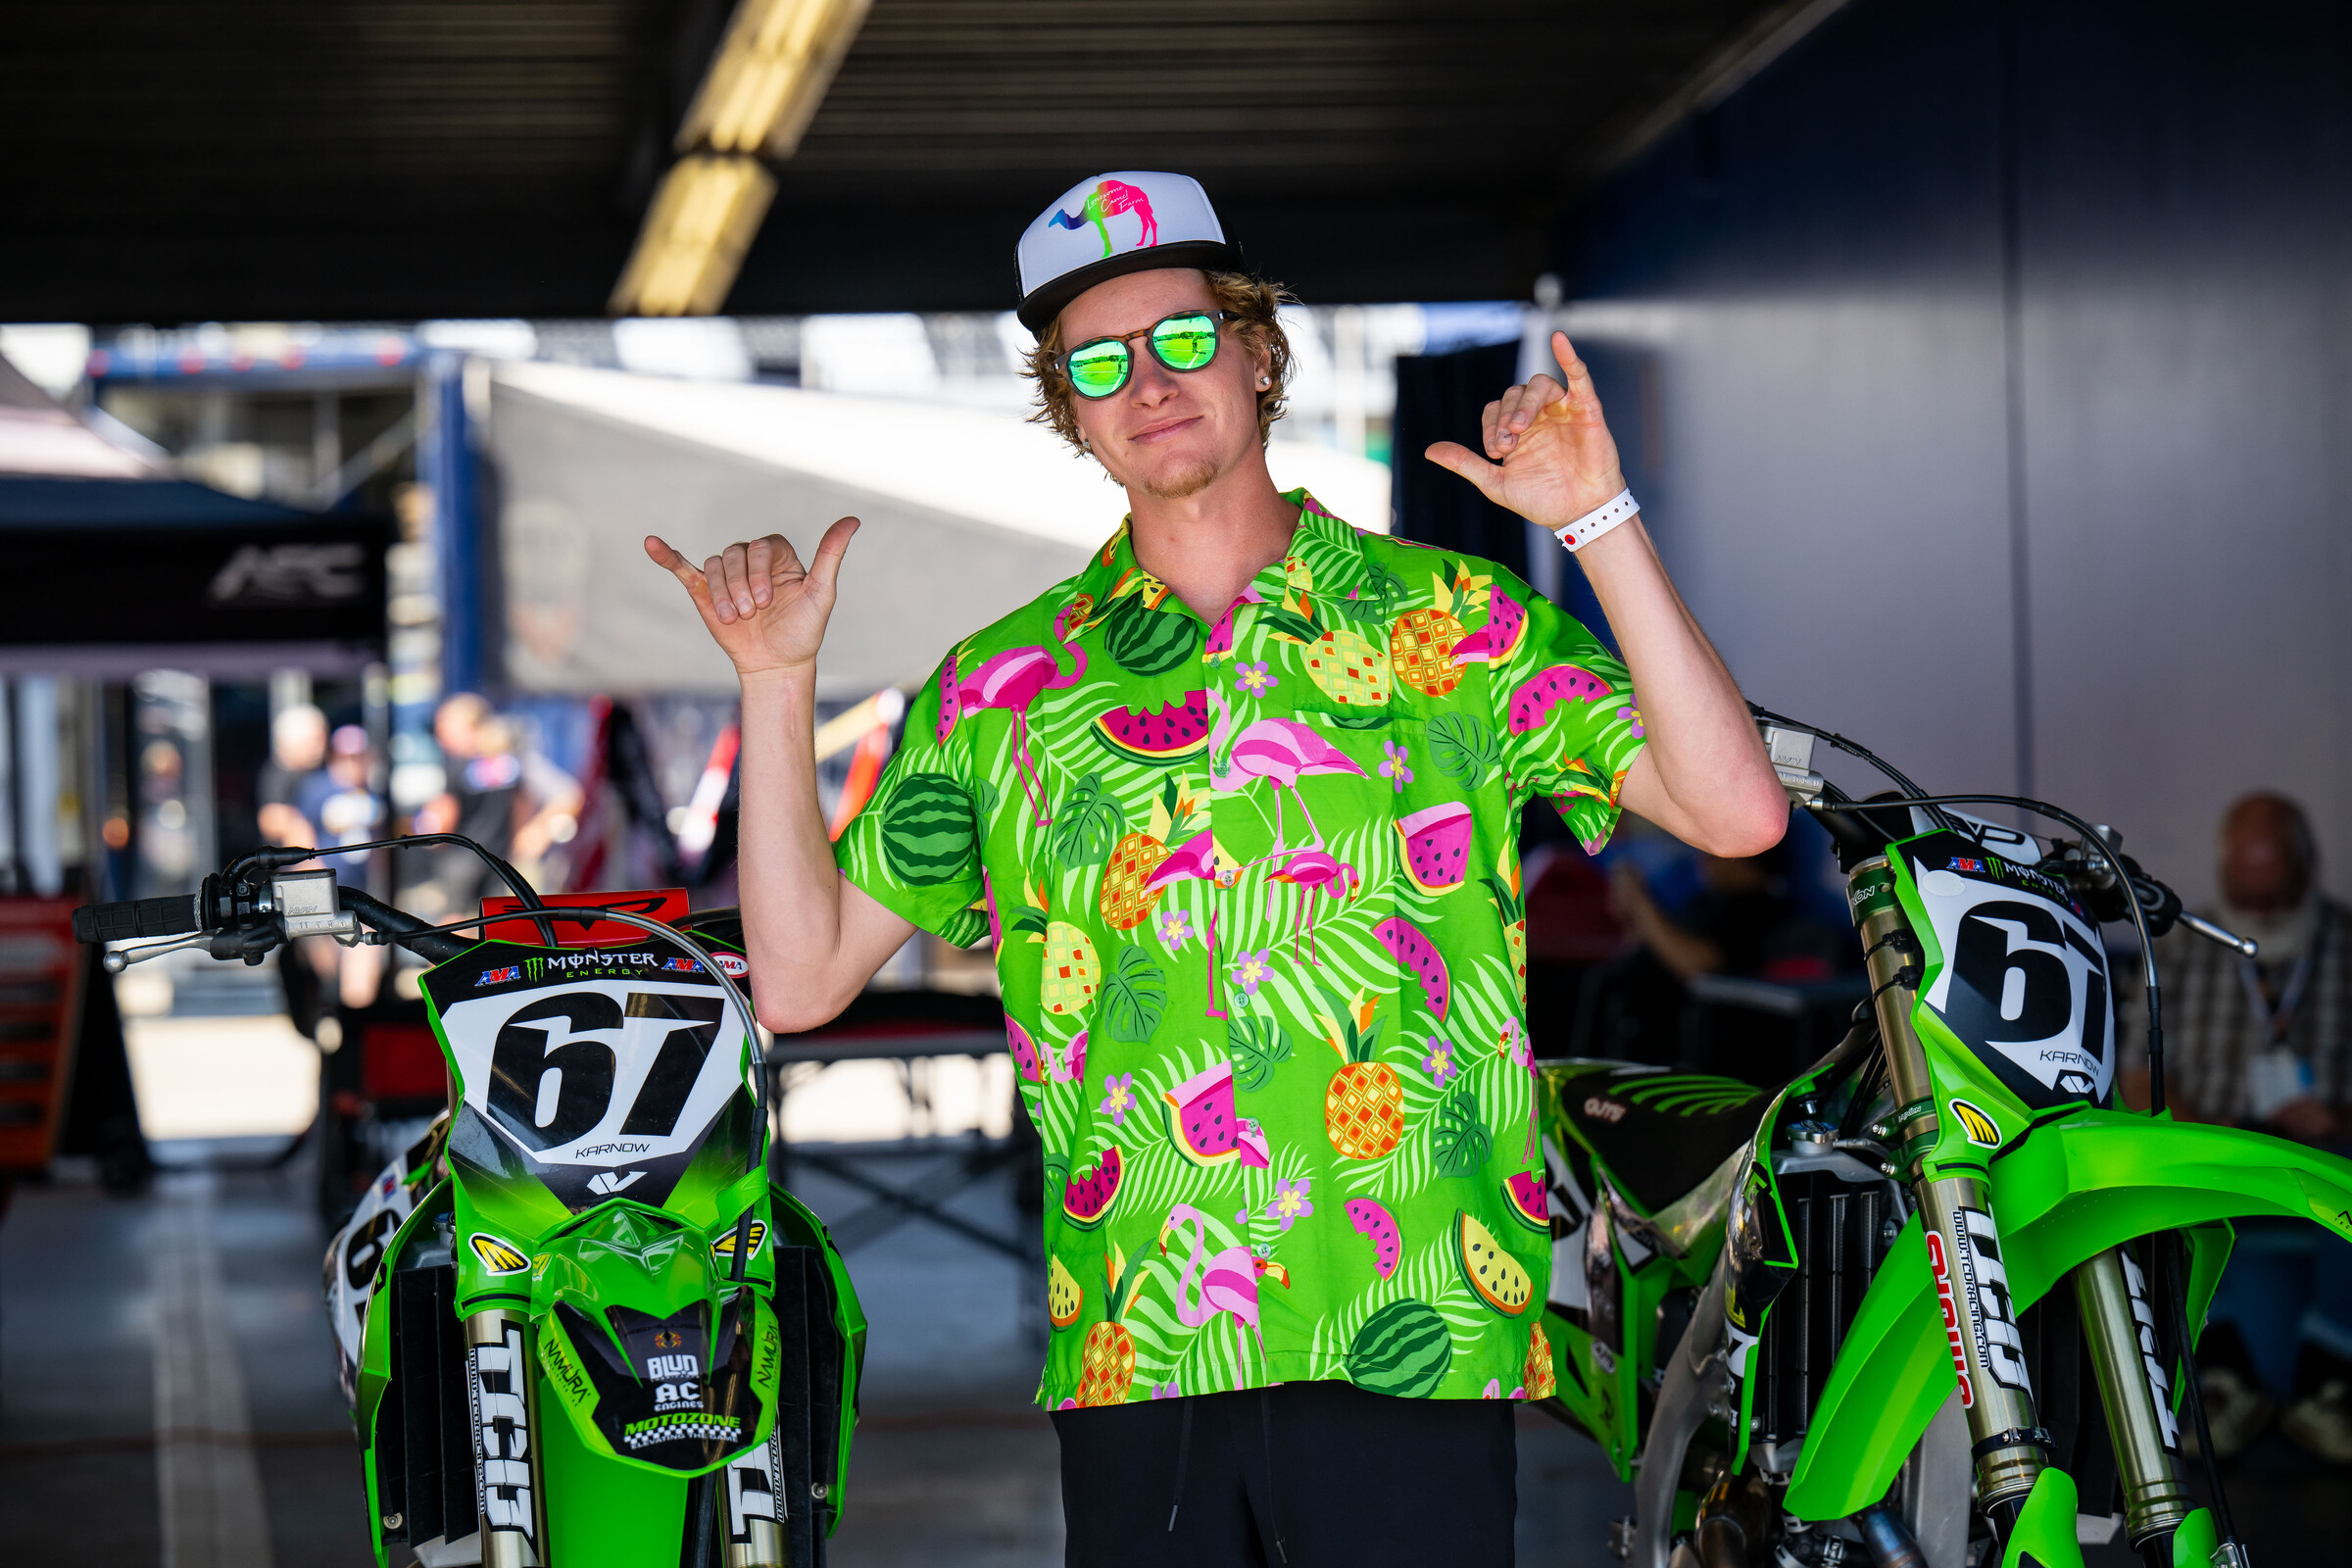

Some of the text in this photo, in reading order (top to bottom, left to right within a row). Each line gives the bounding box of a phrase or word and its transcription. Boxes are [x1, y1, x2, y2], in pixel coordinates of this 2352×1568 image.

[1101, 189, 1128, 213] Camel
[1118, 197, 1145, 212] Farm
[1946, 857, 1986, 873] AMA
[548, 948, 659, 970] MONSTER
[661, 957, 706, 973] AMA
[474, 965, 520, 987] AMA
[566, 968, 643, 979] ENERGY
[1947, 900, 2106, 1065] 67
[486, 992, 725, 1152] 67
[2039, 1050, 2100, 1076] KARNOW
[575, 1142, 650, 1159] KARNOW
[544, 1339, 590, 1402] NAMURA
[655, 1382, 701, 1402] AC
[624, 1412, 742, 1436] MOTOZONE
